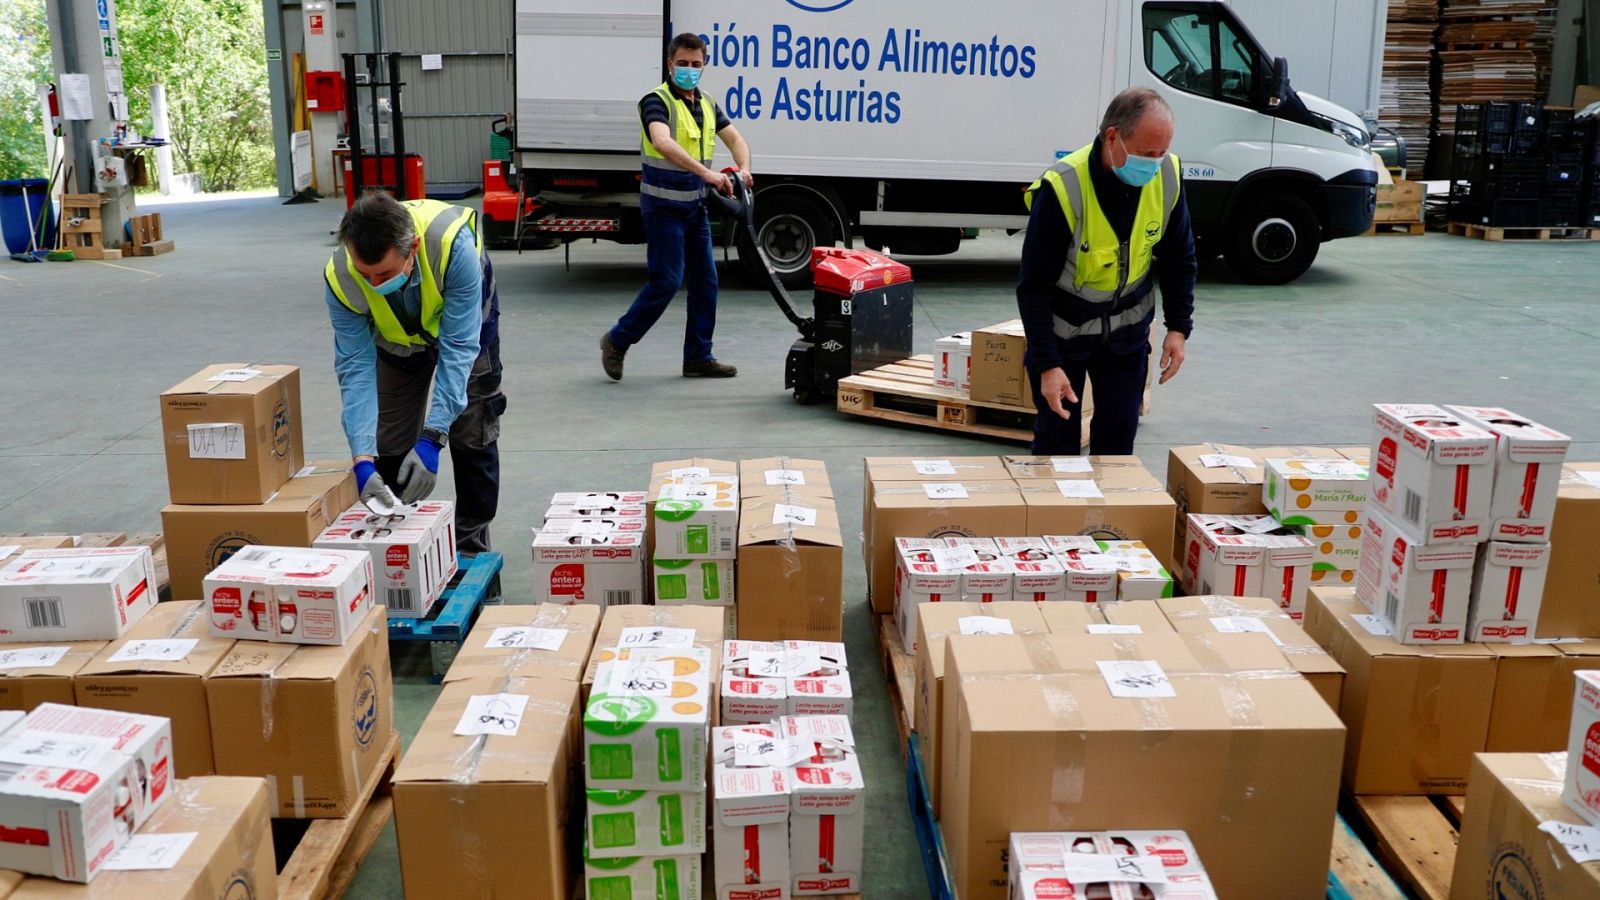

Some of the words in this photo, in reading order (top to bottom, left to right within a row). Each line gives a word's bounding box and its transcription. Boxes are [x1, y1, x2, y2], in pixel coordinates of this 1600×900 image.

[772, 24, 870, 71] Banco
[878, 28, 1037, 78] Alimentos
[725, 76, 762, 120] de
[771, 77, 901, 124] Asturias
[551, 576, 581, 584] entera
